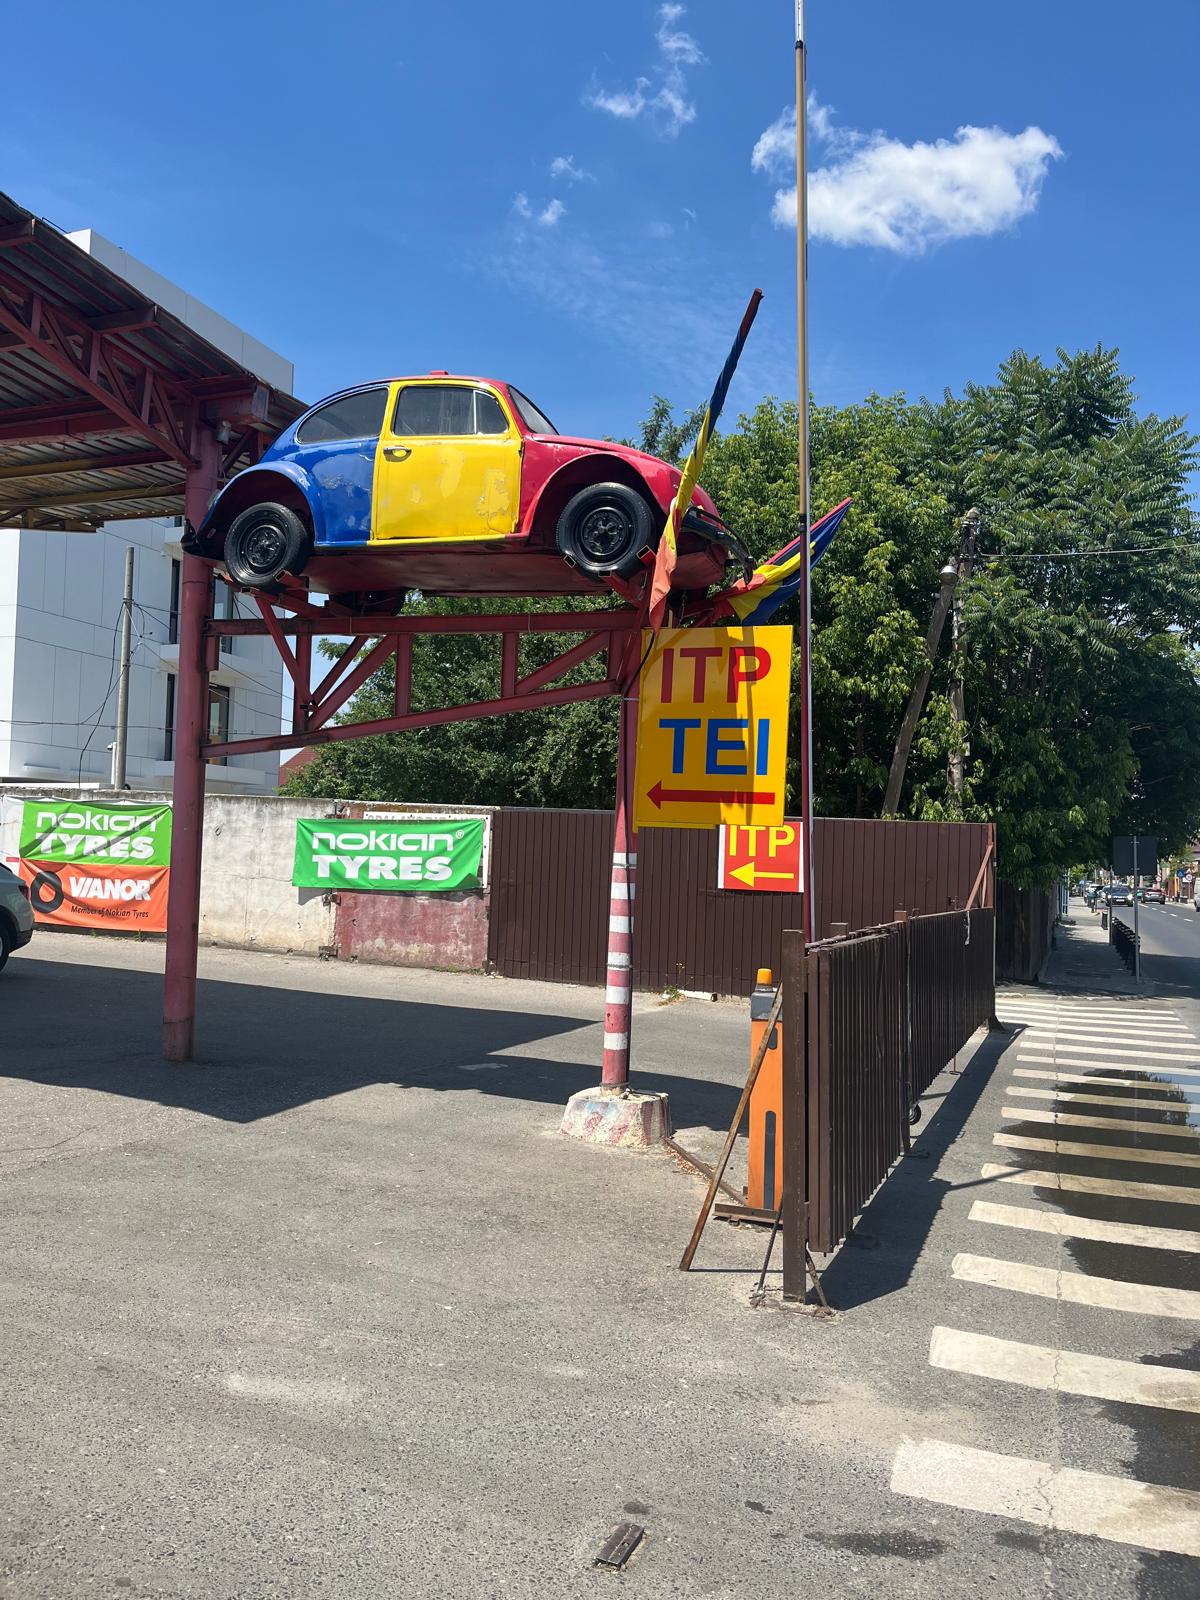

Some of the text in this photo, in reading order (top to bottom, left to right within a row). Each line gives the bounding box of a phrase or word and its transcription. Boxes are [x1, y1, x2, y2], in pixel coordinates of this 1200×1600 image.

[660, 646, 772, 704] ITP
[658, 718, 770, 776] TEI
[35, 832, 154, 859] TYRES
[729, 825, 796, 857] ITP
[312, 854, 453, 881] TYRES
[69, 876, 151, 901] VIANOR
[71, 905, 149, 919] Member of Nokian Tyres
